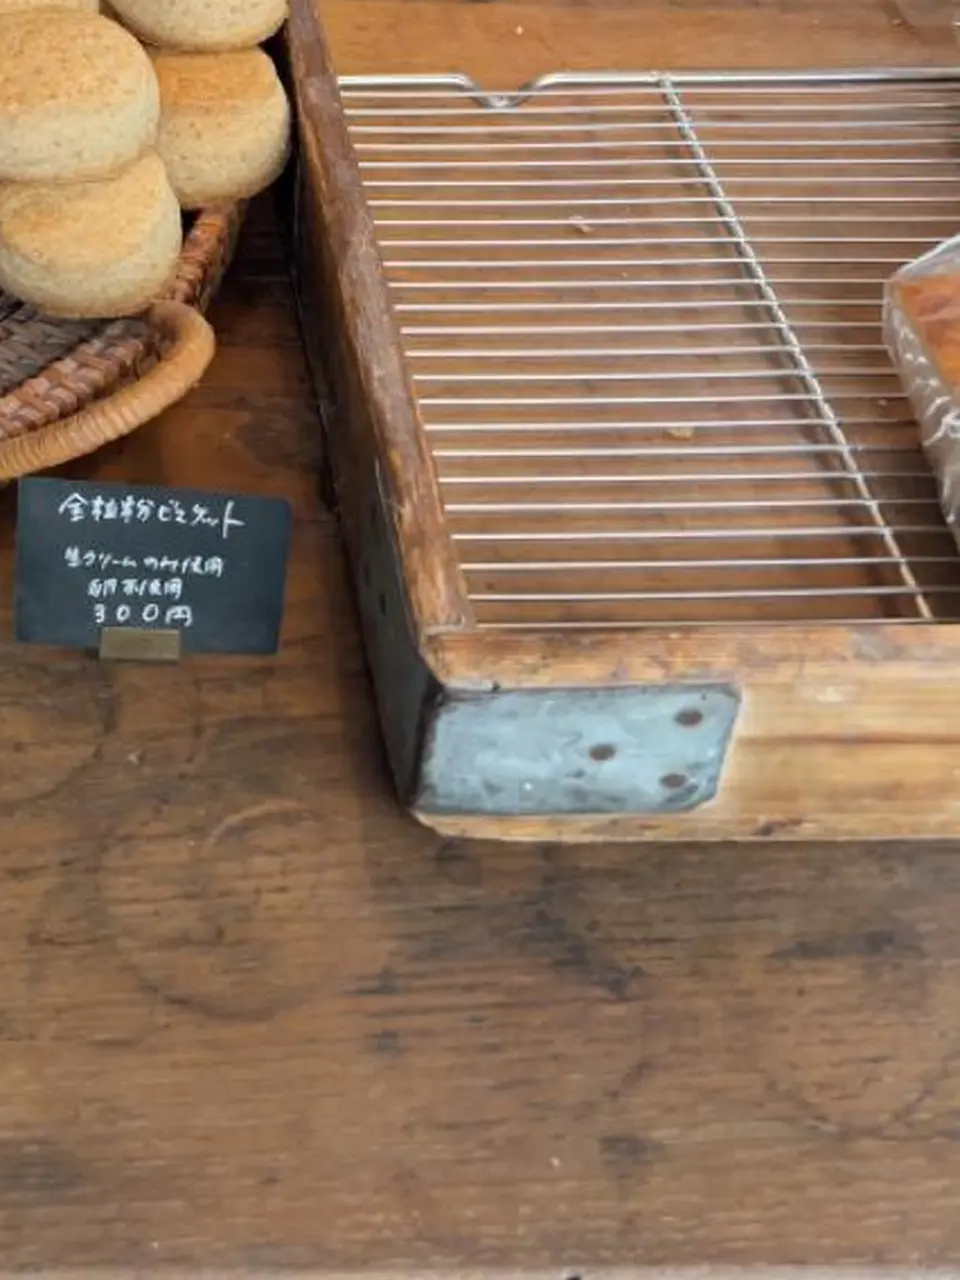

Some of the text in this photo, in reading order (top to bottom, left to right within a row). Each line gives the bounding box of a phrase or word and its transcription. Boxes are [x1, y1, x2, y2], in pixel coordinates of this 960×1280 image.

[58, 492, 246, 539] 全粒粉ビスケット
[93, 602, 194, 628] 300円
